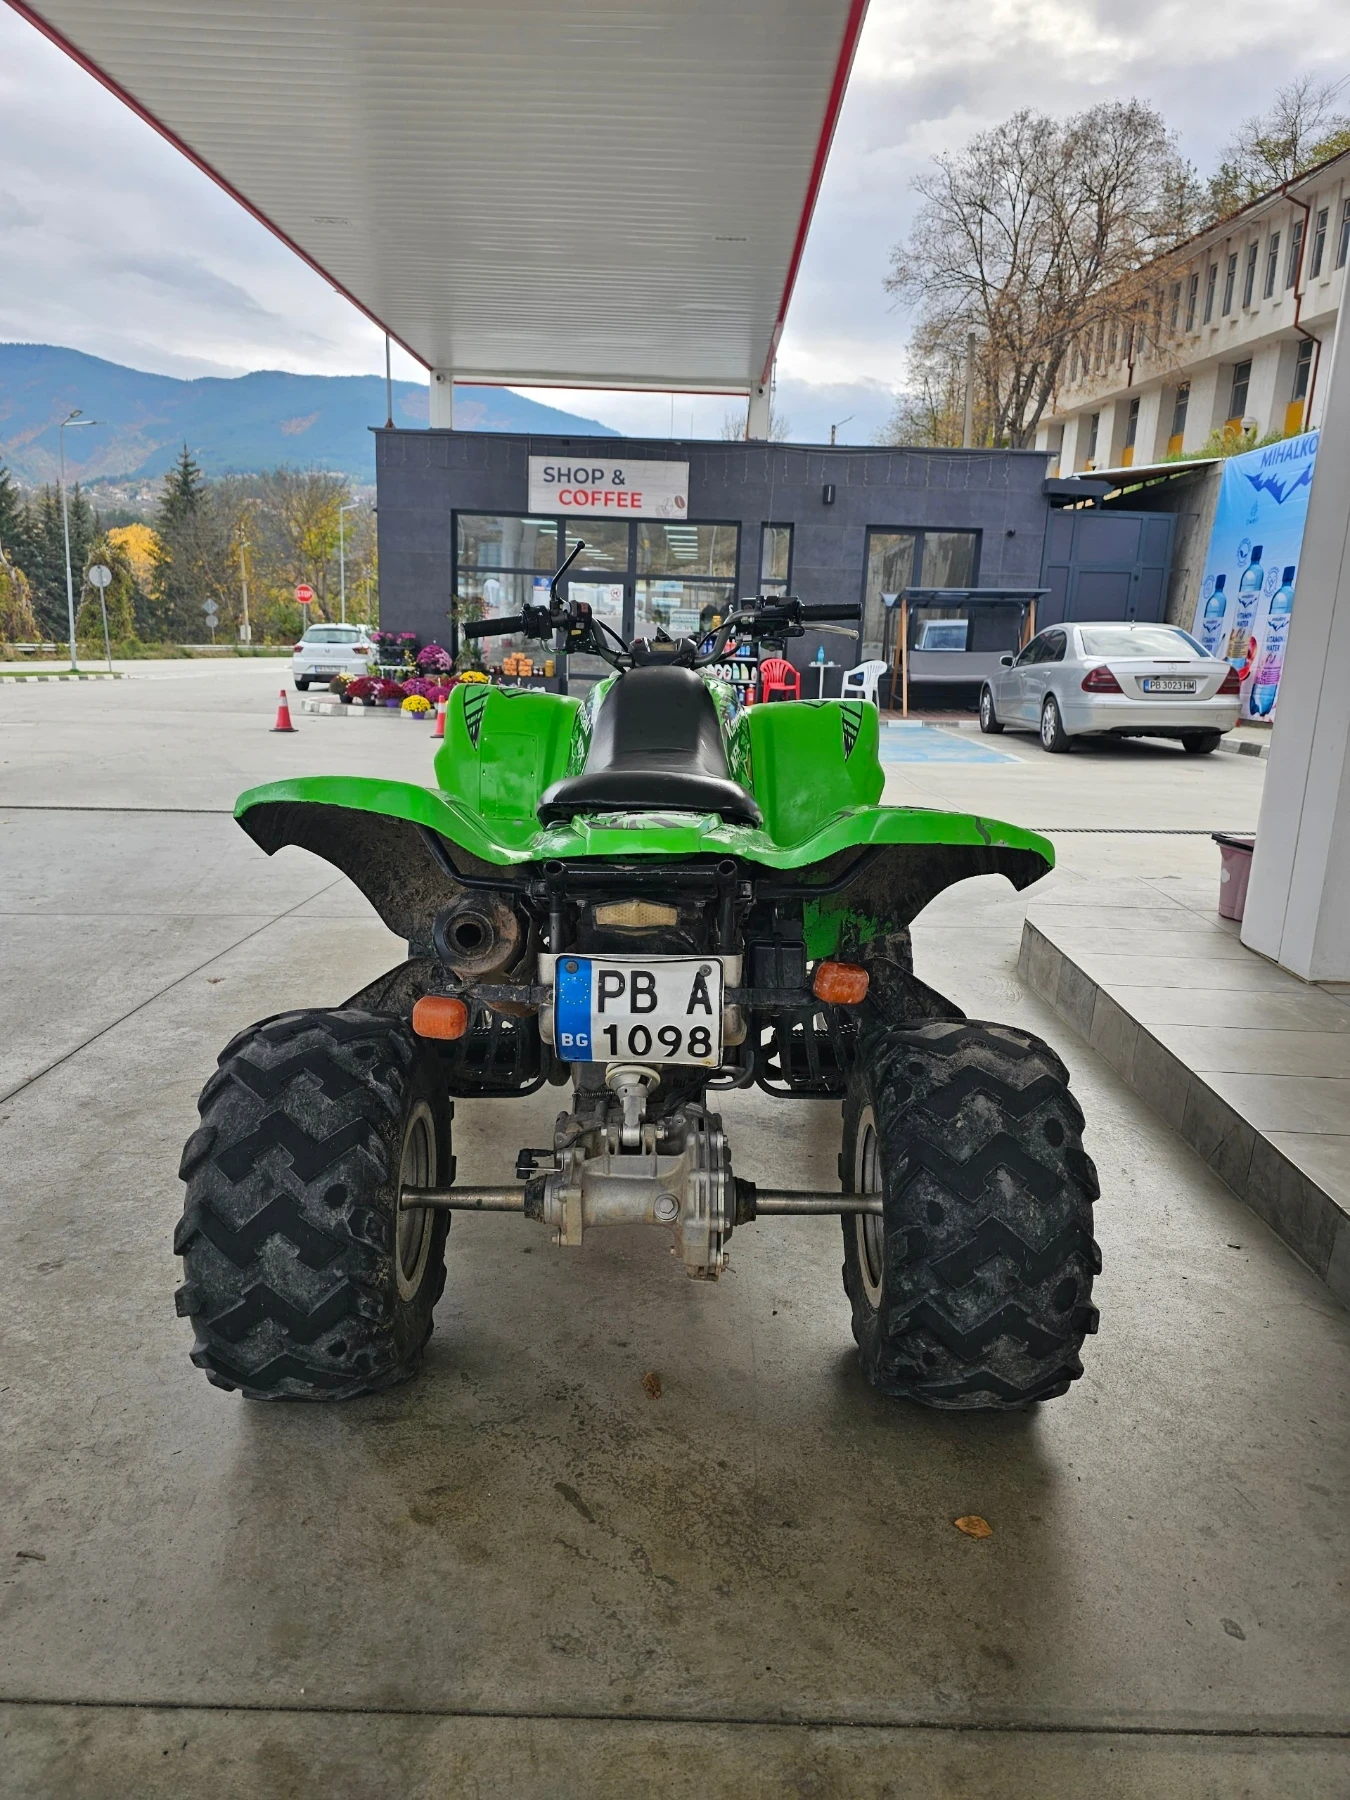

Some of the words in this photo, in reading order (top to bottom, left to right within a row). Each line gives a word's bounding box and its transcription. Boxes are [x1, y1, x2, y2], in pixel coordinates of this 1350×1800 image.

[543, 466, 605, 484] SHOP
[612, 469, 626, 486] &
[558, 489, 643, 509] COFFEE
[297, 589, 313, 599] STOP
[1162, 681, 1182, 690] 3023
[597, 969, 658, 1014] PB
[686, 971, 713, 1015] A
[561, 1032, 589, 1047] BG
[603, 1024, 712, 1058] 1098
